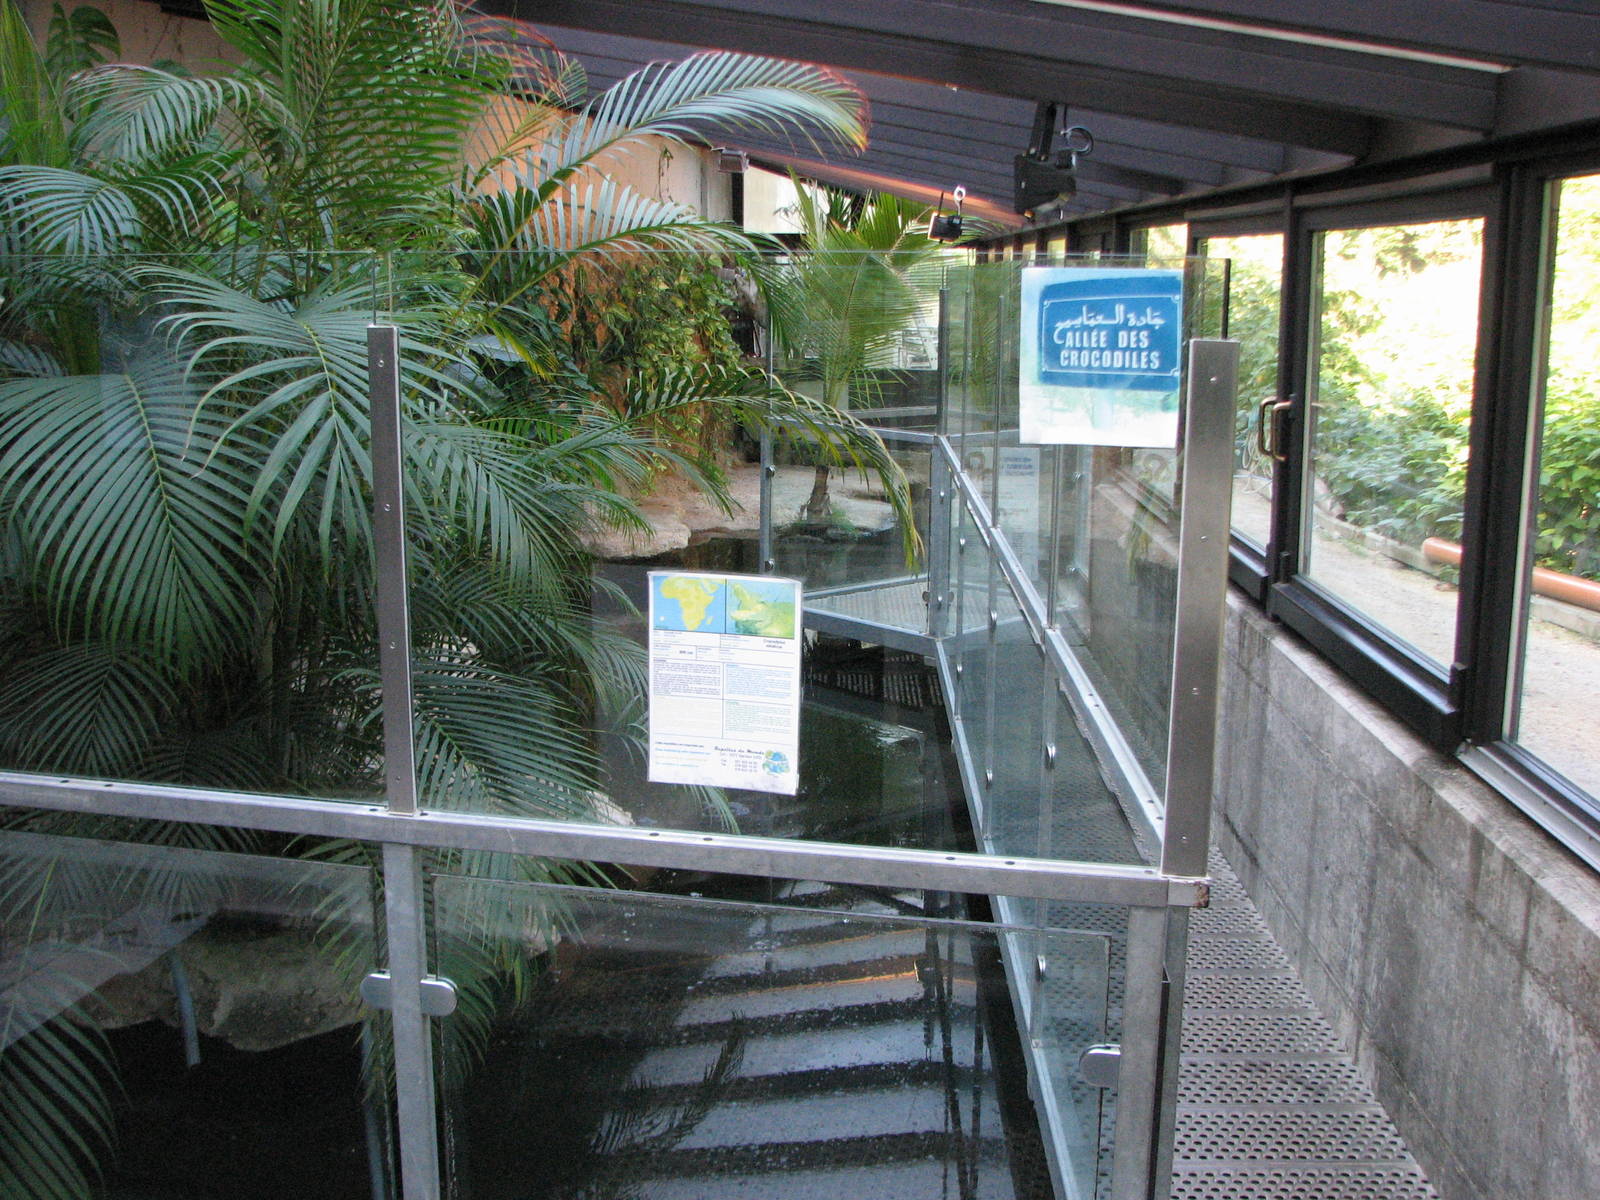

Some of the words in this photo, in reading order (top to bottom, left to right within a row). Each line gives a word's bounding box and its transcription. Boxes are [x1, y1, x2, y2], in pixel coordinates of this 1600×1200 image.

[1065, 328, 1108, 348] ALLÉE
[1118, 330, 1150, 348] DES
[1060, 349, 1161, 370] CROCODILES
